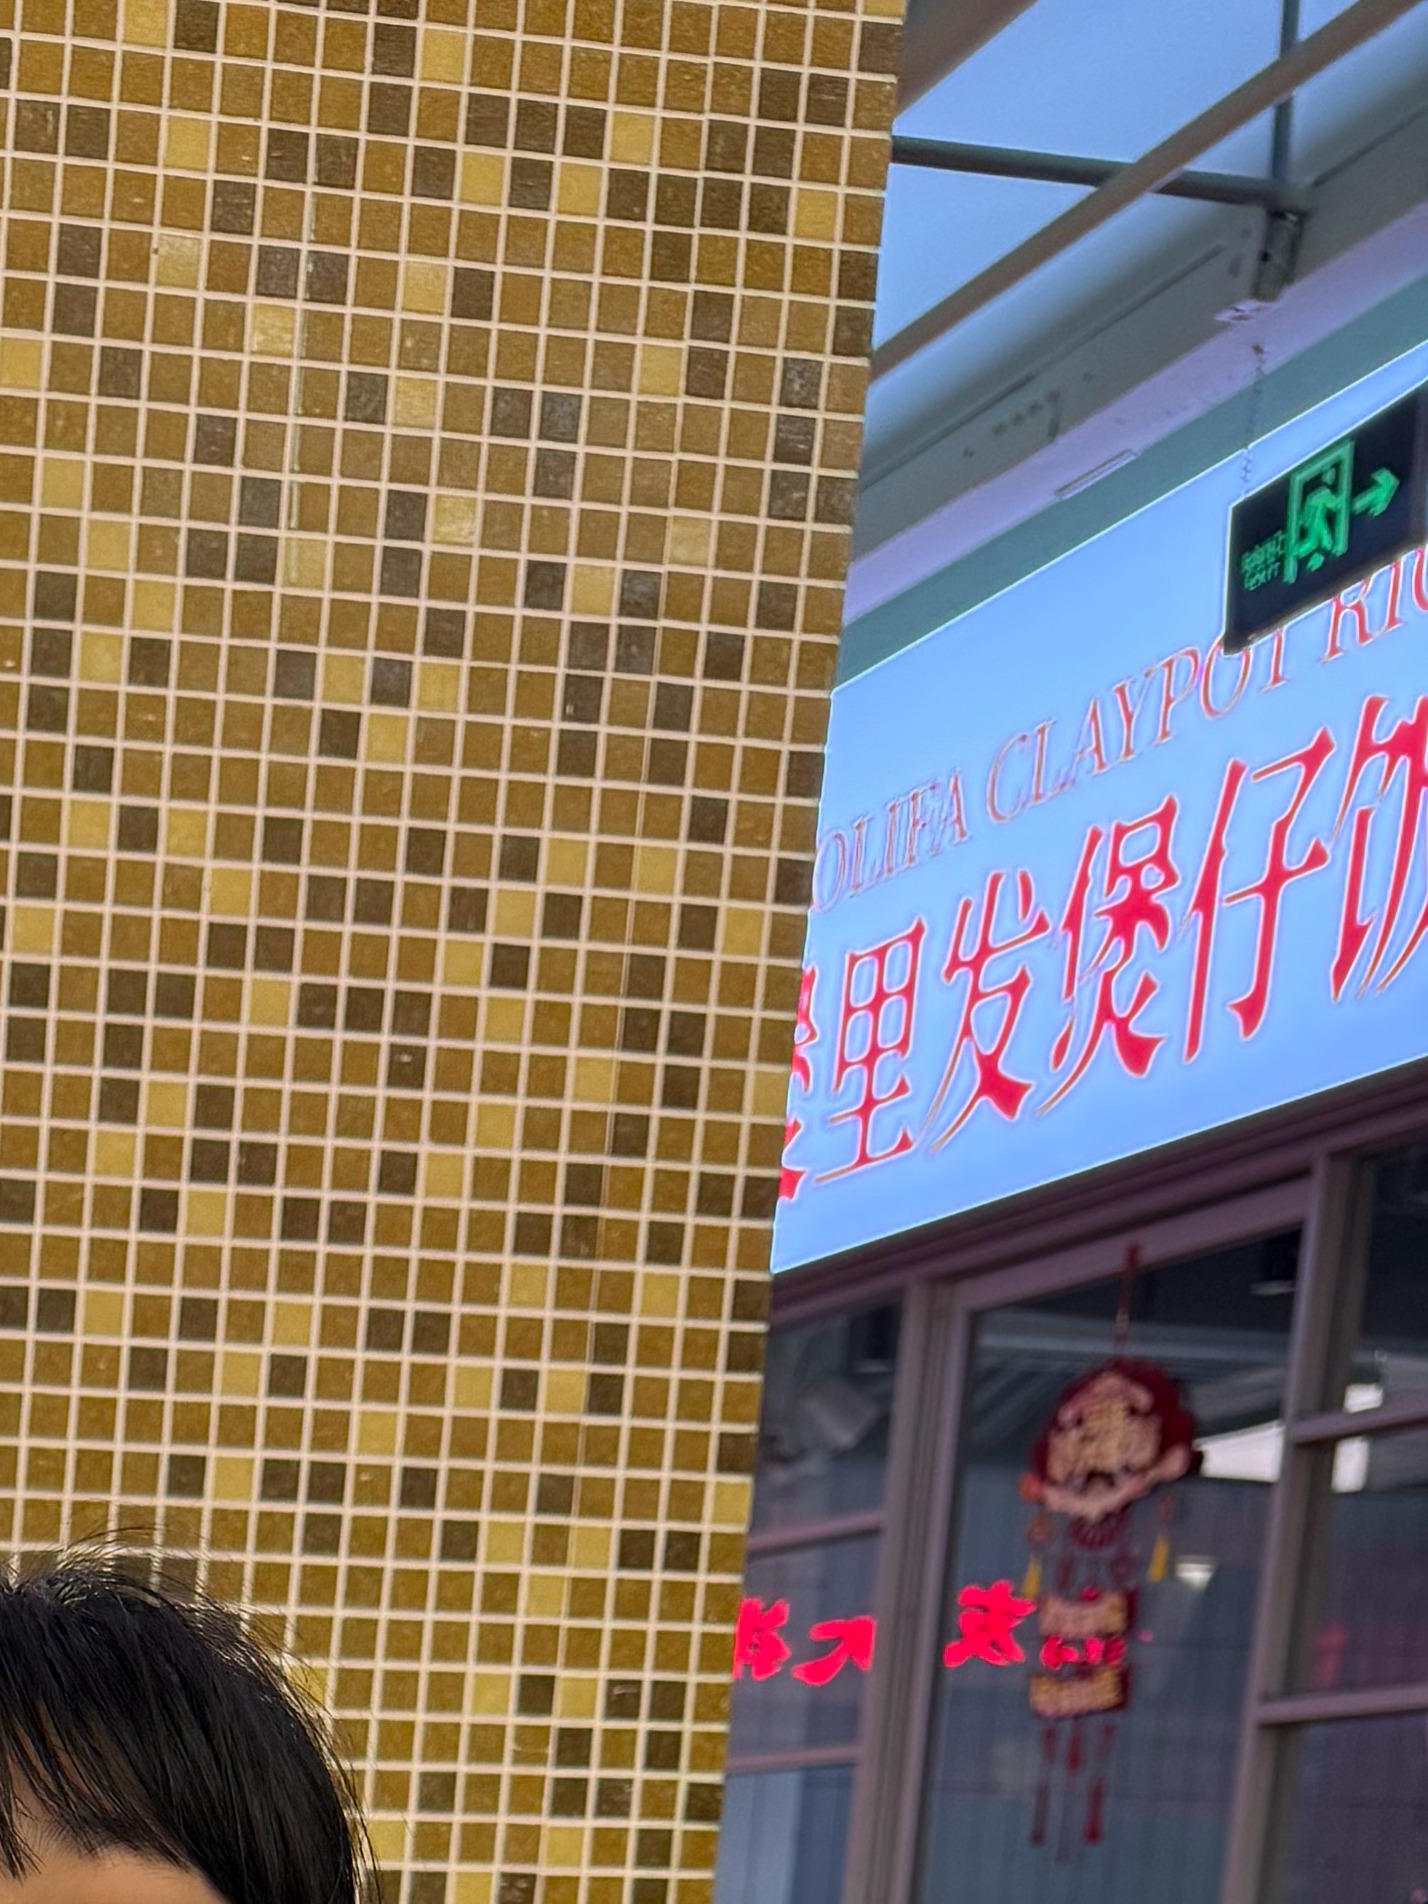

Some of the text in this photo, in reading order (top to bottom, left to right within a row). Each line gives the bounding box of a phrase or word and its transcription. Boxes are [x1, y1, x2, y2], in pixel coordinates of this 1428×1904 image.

[780, 695, 1428, 1203] 里发煲仔饭
